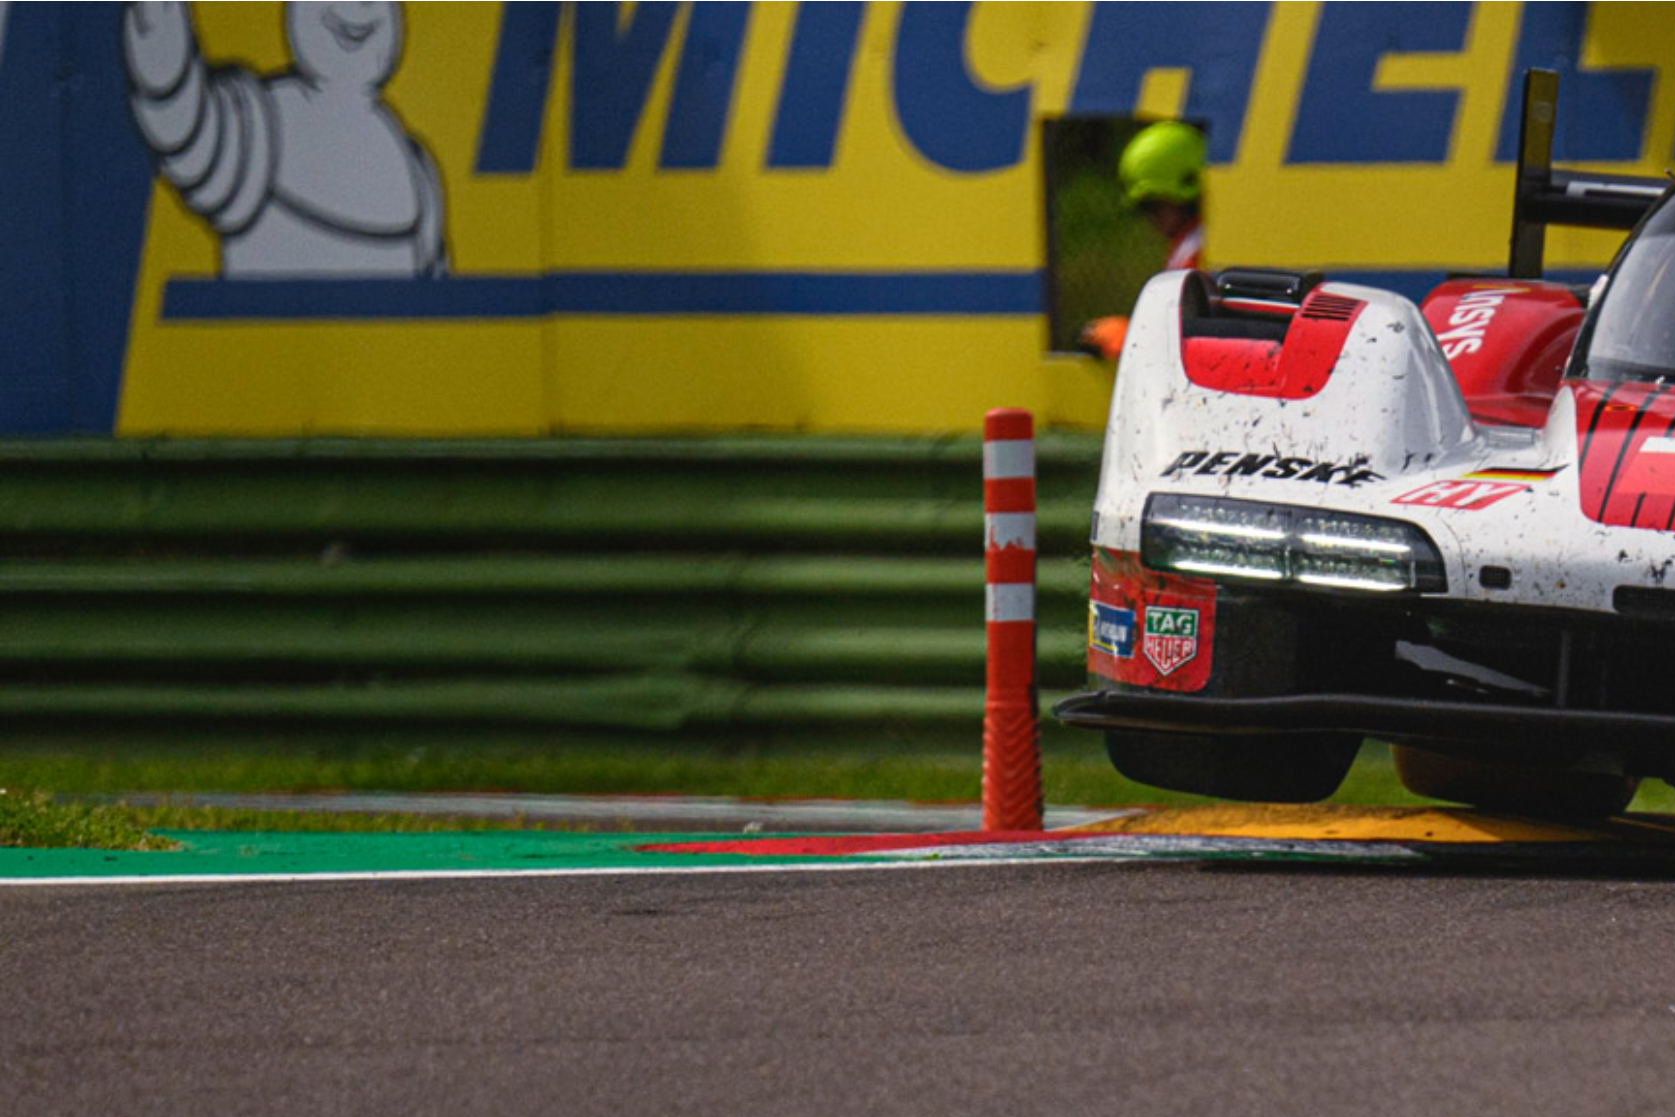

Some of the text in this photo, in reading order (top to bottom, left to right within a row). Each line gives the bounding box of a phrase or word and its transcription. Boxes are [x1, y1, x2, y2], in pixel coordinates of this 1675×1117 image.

[1436, 284, 1531, 360] Ansys
[1160, 450, 1387, 488] PENSKE
[1149, 612, 1193, 634] TAG
[1145, 636, 1193, 669] HEUER
